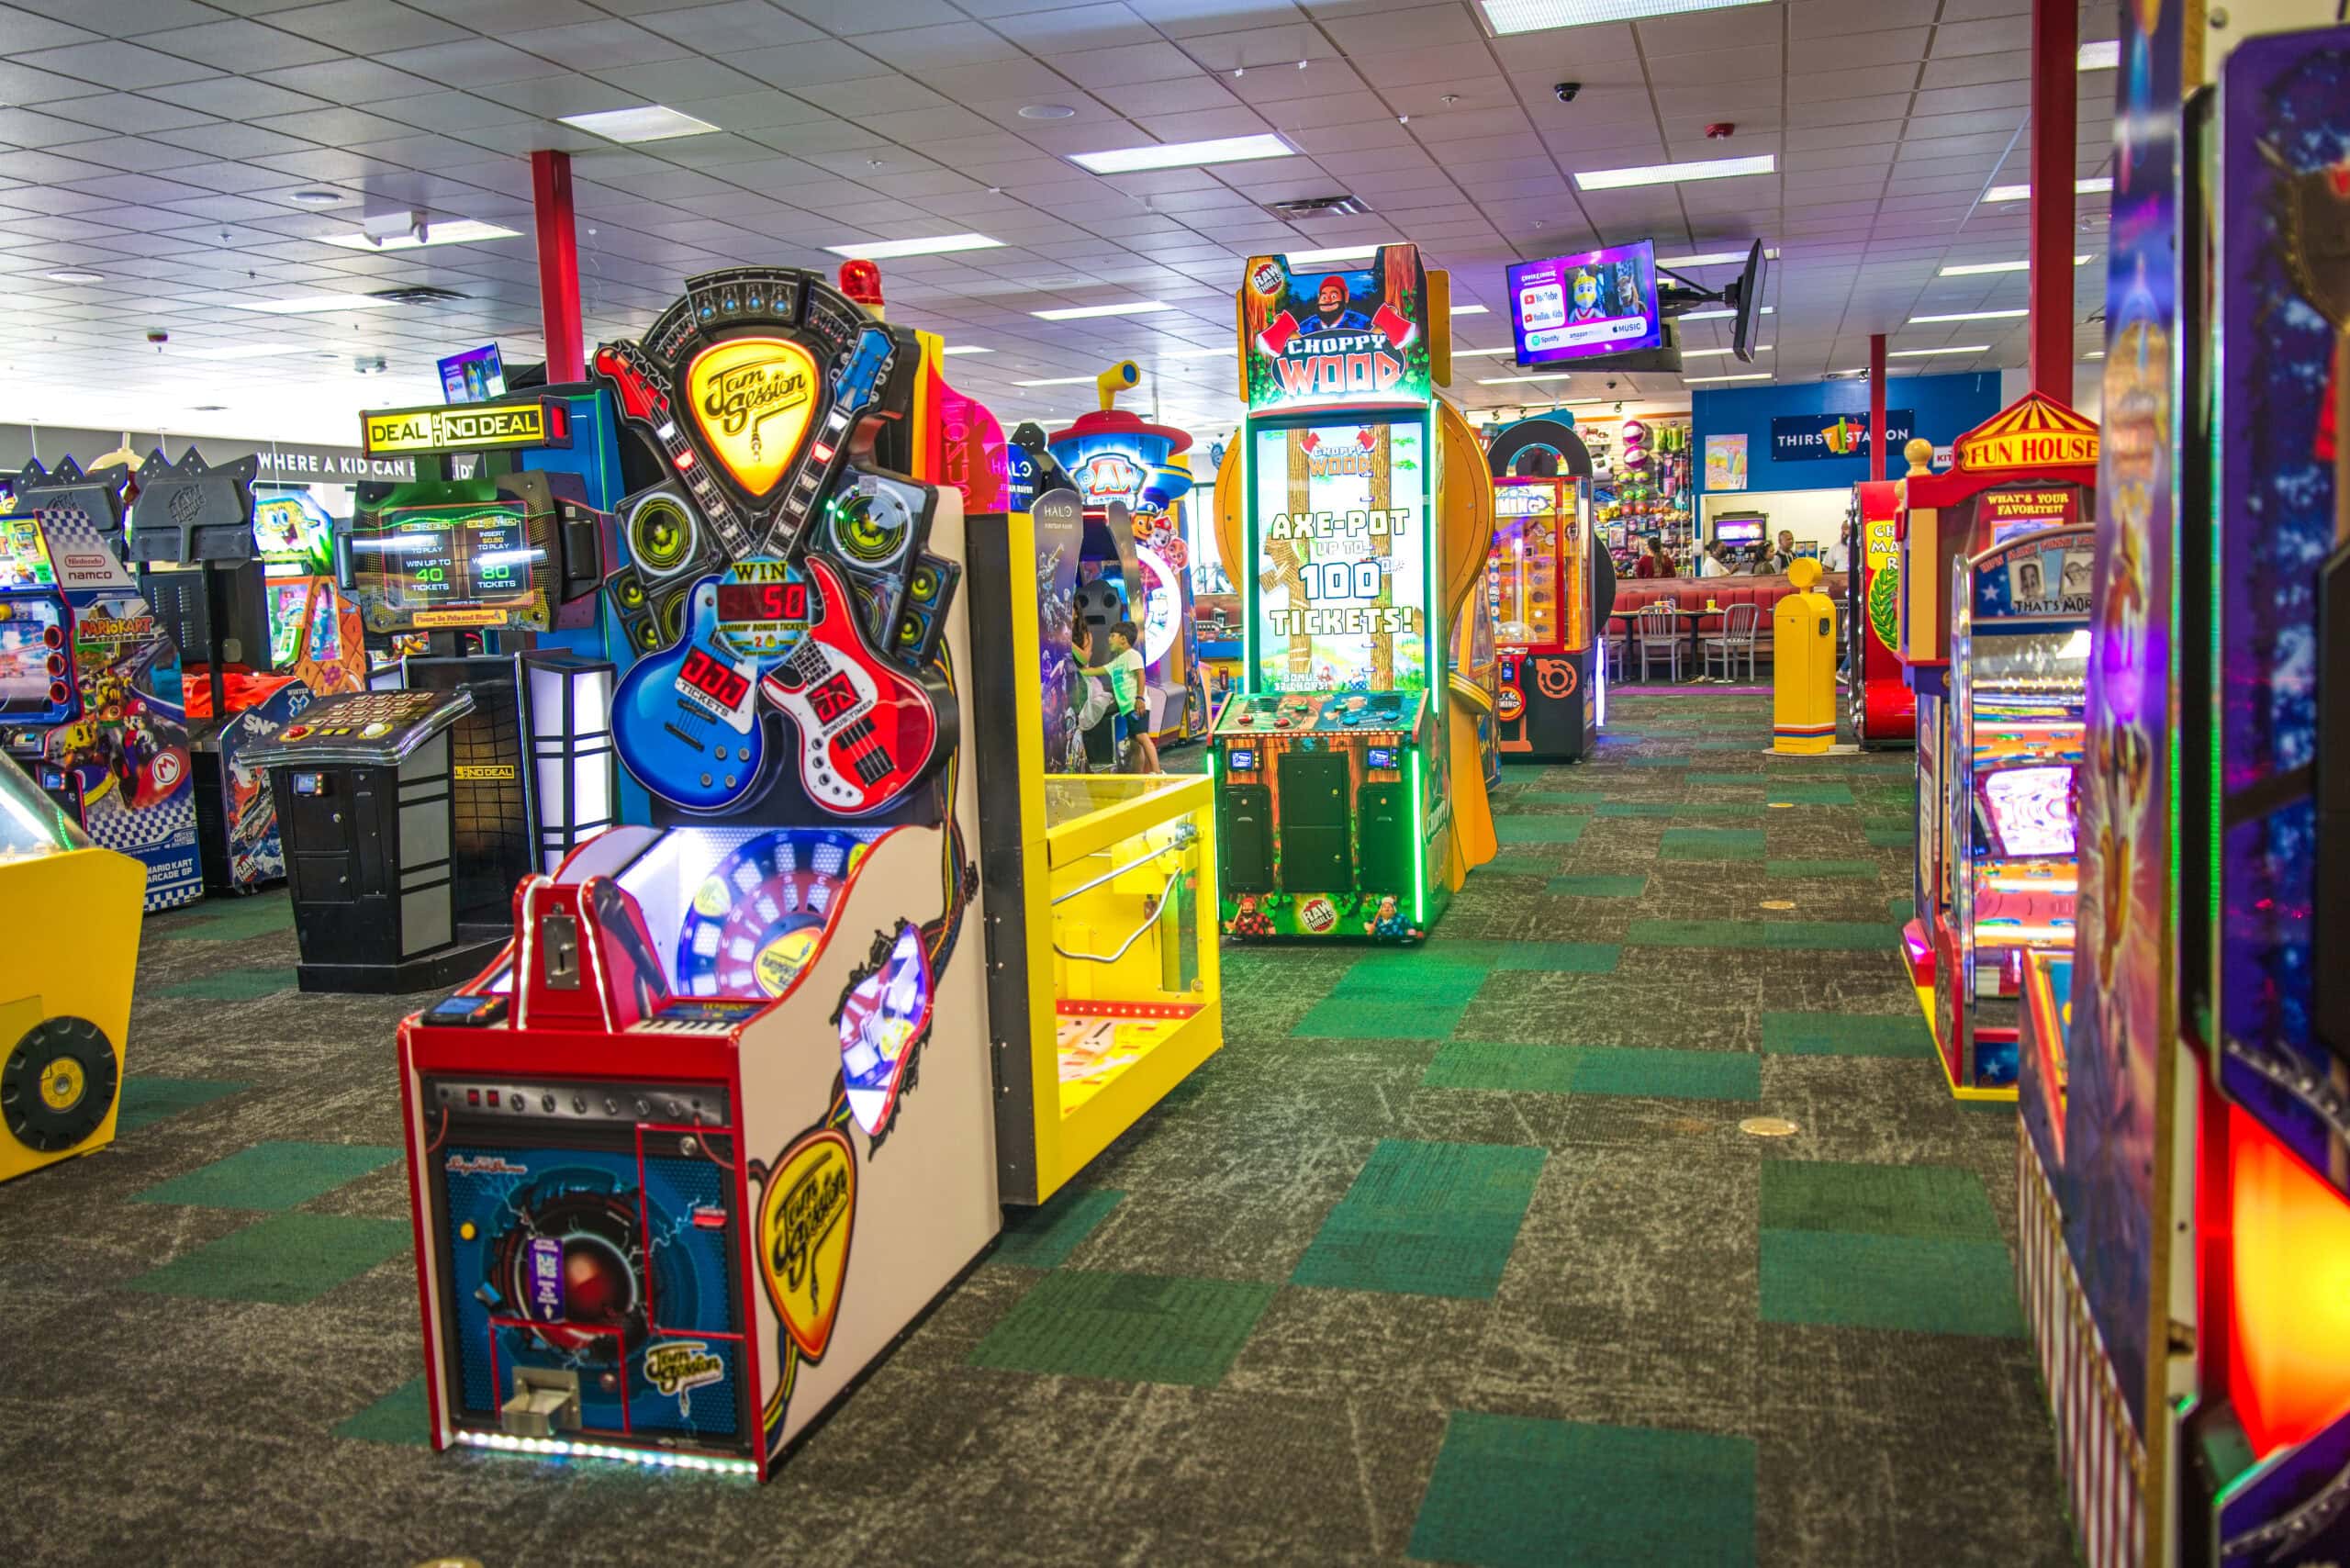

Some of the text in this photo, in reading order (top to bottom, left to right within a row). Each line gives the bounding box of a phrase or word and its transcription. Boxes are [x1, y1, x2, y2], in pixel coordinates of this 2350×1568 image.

[1536, 291, 1558, 302] YouTube
[1618, 323, 1640, 333] MUSIC
[1287, 331, 1387, 354] CHOPPY
[1540, 335, 1560, 343] Spotify
[1277, 351, 1402, 397] WOOD
[705, 359, 777, 417] Jam
[723, 373, 807, 433] Session
[371, 412, 539, 446] DEAL OR NO DEAL
[1777, 429, 1909, 447] THIRST STAON
[1936, 454, 1953, 463] KIT
[1971, 438, 2099, 465] FUN HOUSE
[256, 452, 319, 473] WHERE
[324, 456, 336, 473] A
[340, 457, 367, 475] KID
[374, 460, 405, 476] CAN
[991, 461, 1033, 477] HALO
[1309, 456, 1371, 476] WOOD
[1079, 462, 1140, 494] PAW
[1987, 493, 2069, 506] WHAT'S YOUR
[1044, 506, 1073, 518] HALO
[1270, 508, 1410, 541] AXE-POT
[1316, 540, 1364, 556] UP TO
[68, 556, 103, 566] Nintendo
[68, 571, 112, 580] namco
[416, 567, 443, 582] 40
[482, 565, 509, 579] 80
[732, 561, 789, 582] WIN
[411, 583, 450, 591] TICKETS
[477, 580, 516, 588] TICKETS
[1298, 561, 1382, 600] 100
[764, 585, 806, 618] 50
[2014, 596, 2093, 613] THAT'S MOR
[752, 623, 777, 633] BONUS
[779, 622, 809, 632] TICKETS
[1269, 606, 1414, 636] TICKETS!
[754, 635, 762, 647] 2
[287, 688, 309, 696] WINTER
[678, 681, 731, 718] TICKETS
[469, 767, 484, 777] NO
[485, 767, 513, 777] DEAL
[147, 857, 194, 875] MARIO KART
[147, 867, 193, 883] ARCADE GP
[787, 1163, 848, 1293] Session
[645, 1342, 699, 1380] Jam
[658, 1354, 722, 1394] Session
